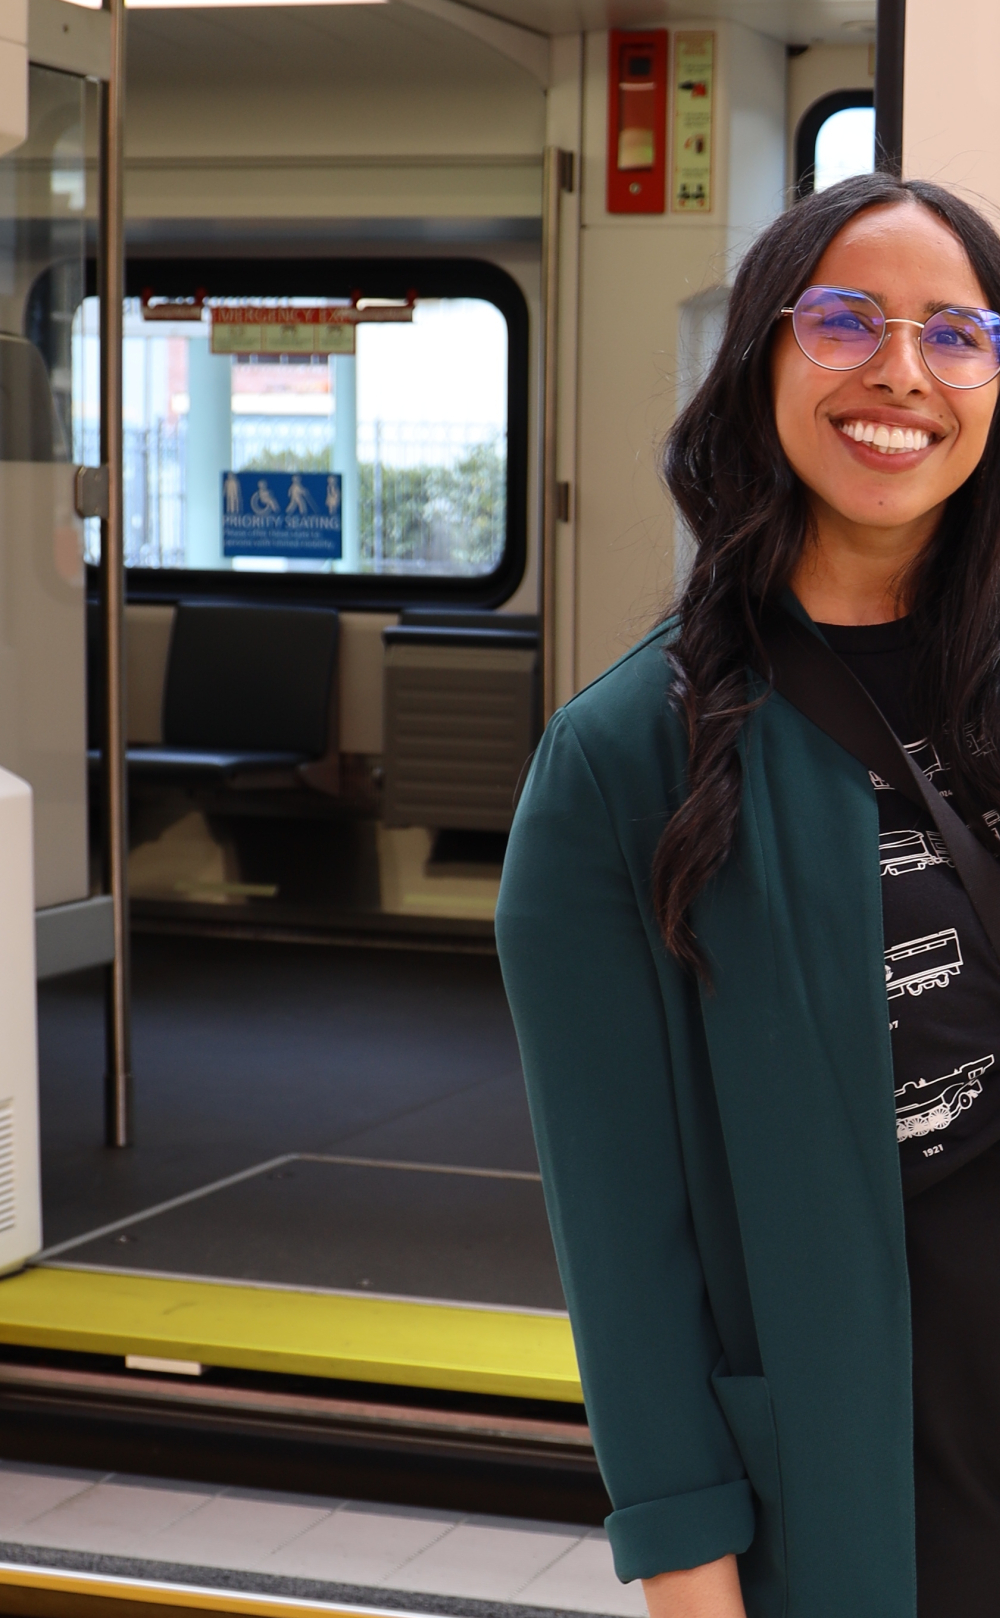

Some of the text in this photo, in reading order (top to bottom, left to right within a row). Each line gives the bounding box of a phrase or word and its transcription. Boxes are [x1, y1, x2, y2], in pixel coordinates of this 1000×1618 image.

[213, 308, 311, 322] MERGENCY
[223, 515, 339, 530] PRIORITY SEATING
[939, 789, 953, 797] 024
[922, 1144, 944, 1157] 1921
